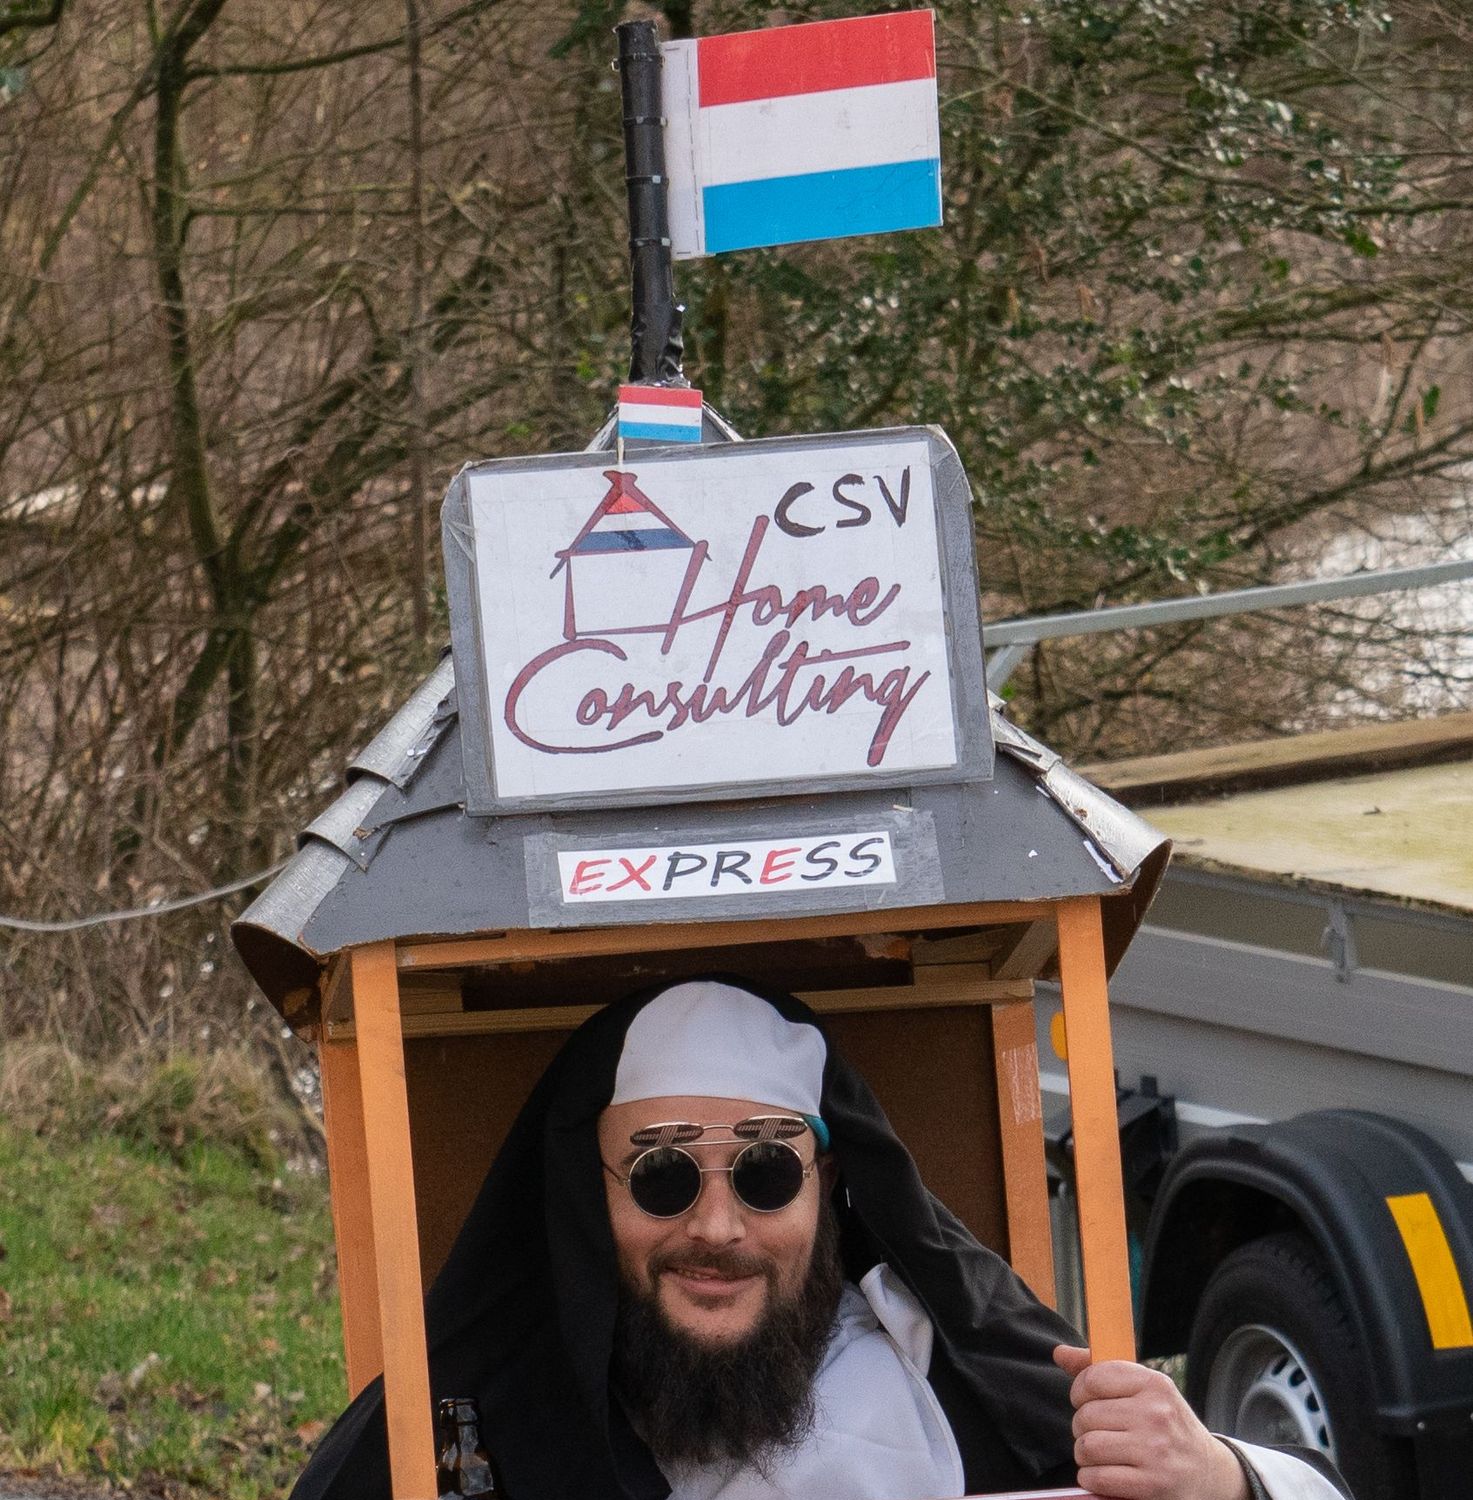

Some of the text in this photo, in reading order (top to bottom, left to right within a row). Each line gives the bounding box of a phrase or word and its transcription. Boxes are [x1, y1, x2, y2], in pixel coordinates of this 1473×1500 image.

[774, 466, 911, 538] CSV
[662, 515, 901, 682] Home
[505, 630, 931, 767] Consulting
[569, 838, 882, 896] EXPRESS
